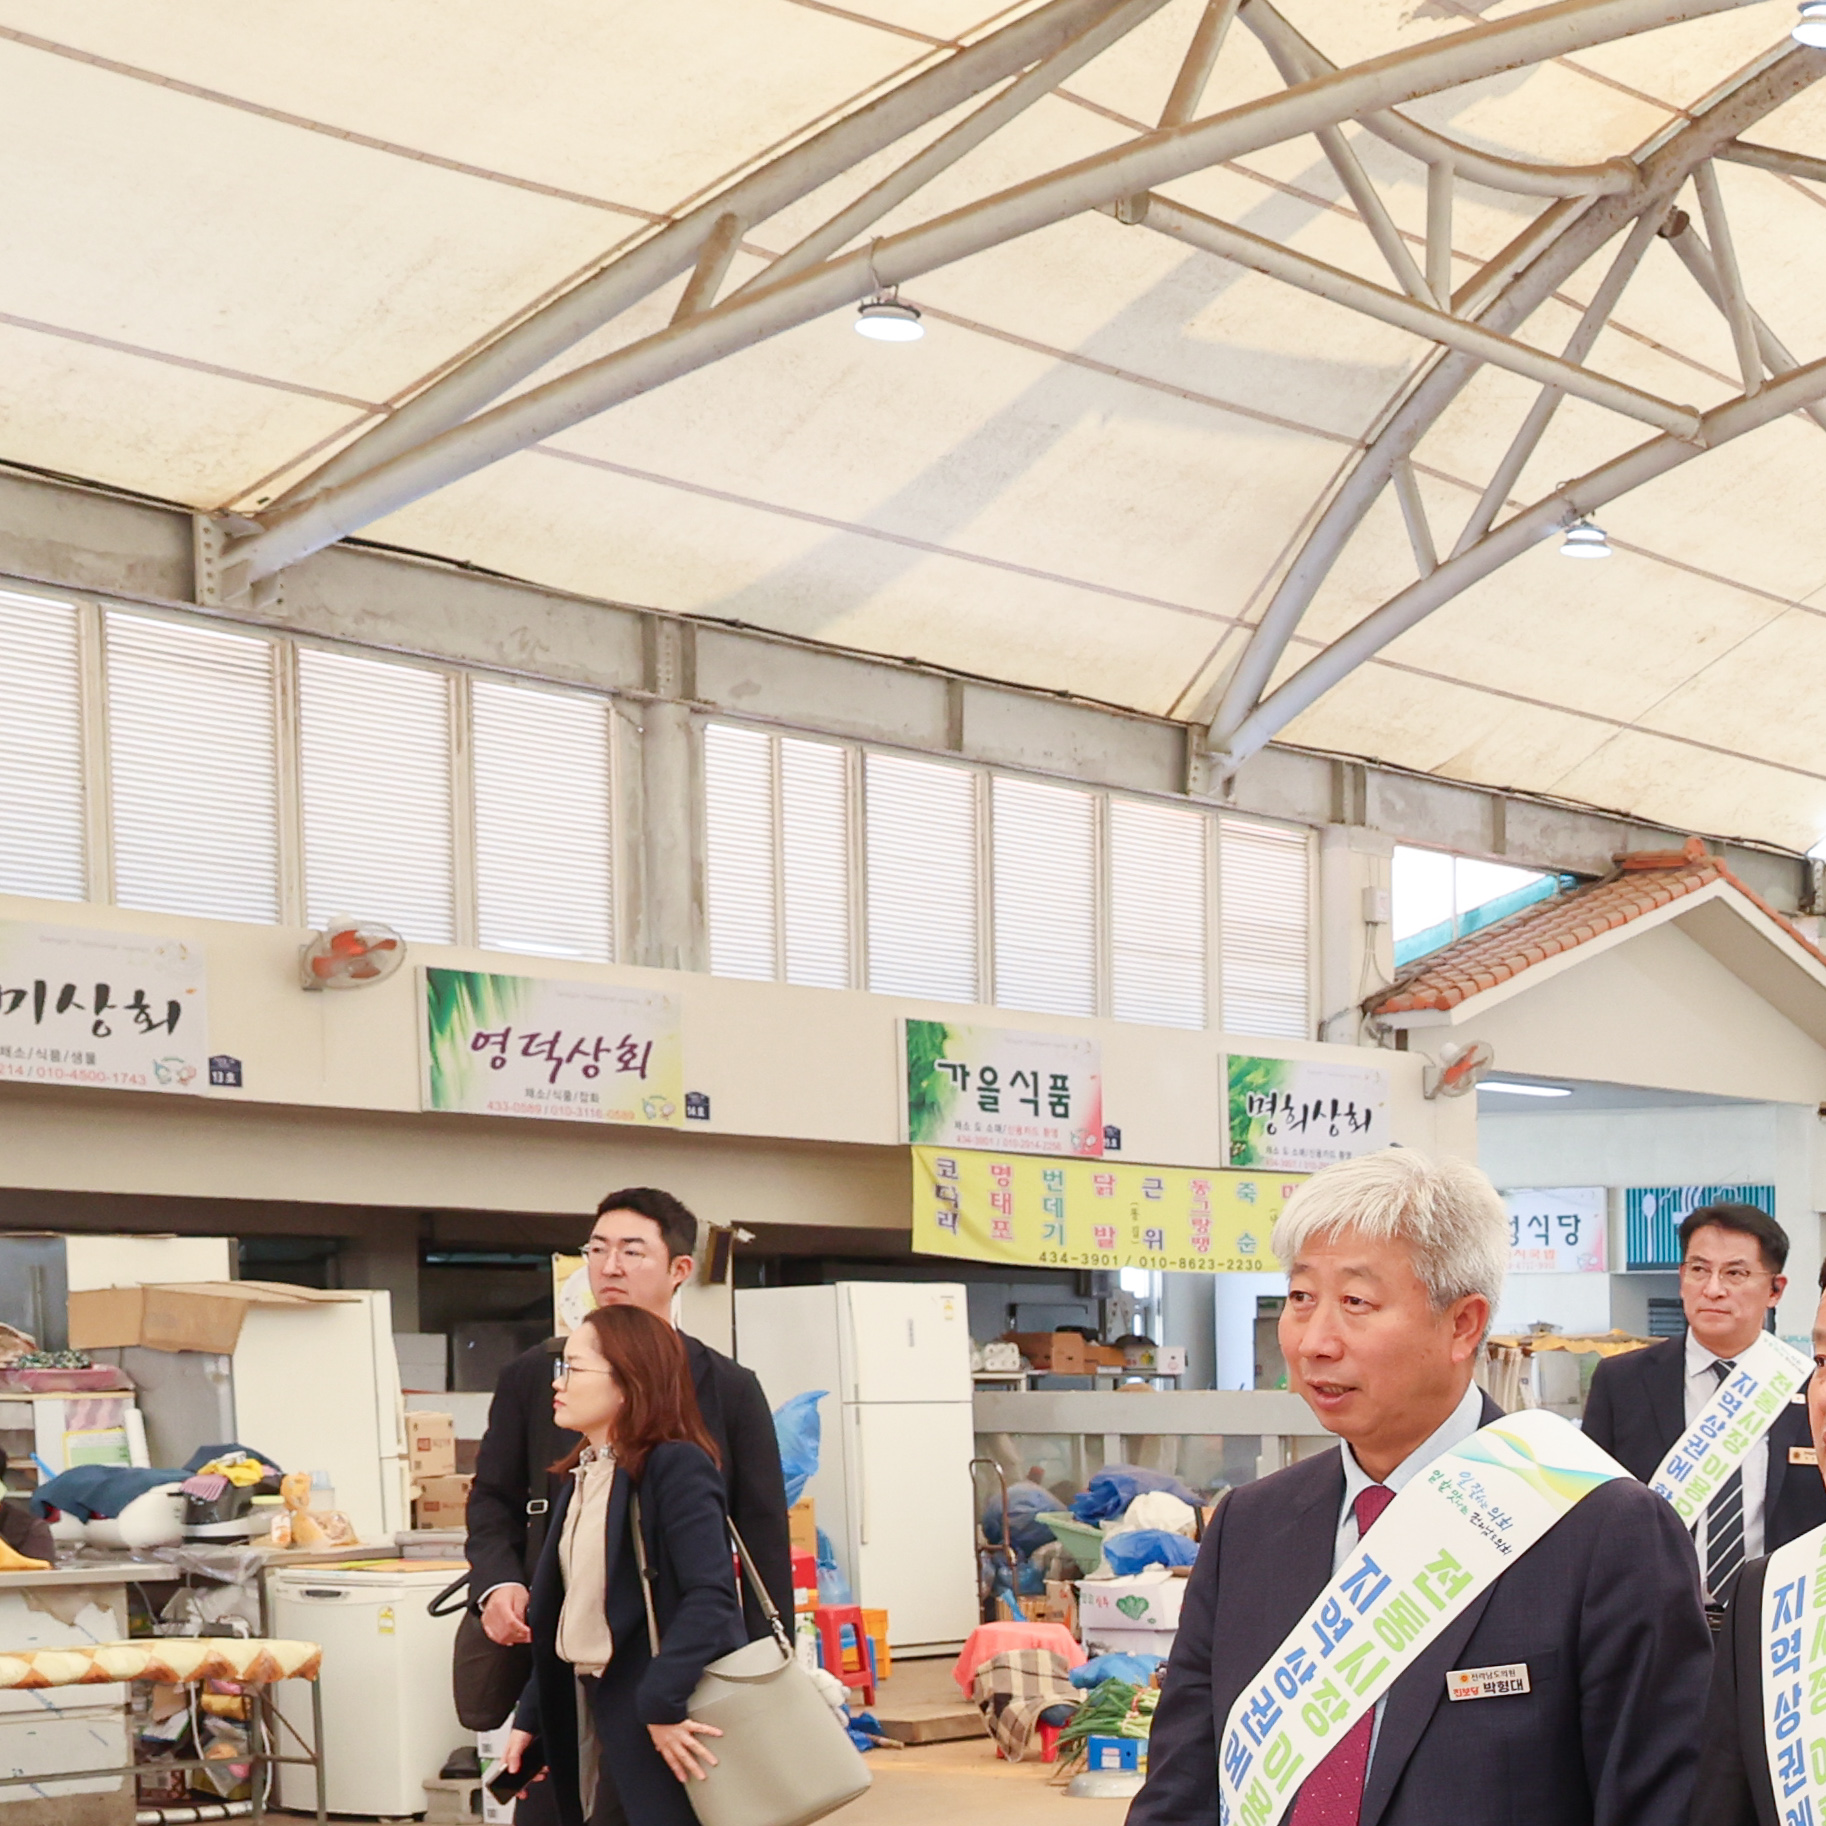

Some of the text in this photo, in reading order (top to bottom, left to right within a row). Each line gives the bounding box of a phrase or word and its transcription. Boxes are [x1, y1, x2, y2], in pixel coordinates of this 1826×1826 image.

[471, 1026, 653, 1084] 영덕상회
[937, 1061, 1071, 1119] 가을식품
[1248, 1091, 1372, 1137] 명희상회
[989, 1163, 1014, 1242] 명태포
[1042, 1168, 1066, 1247] 번데기
[1092, 1173, 1117, 1250] 닭발
[1141, 1177, 1165, 1251] 근위
[1190, 1179, 1212, 1254] 동그랑땡
[1235, 1181, 1258, 1255] 죽순
[1038, 1252, 1119, 1266] 434-3901
[1139, 1256, 1263, 1271] 010-8623-2230
[1666, 1371, 1759, 1483] 지역상권에
[1722, 1370, 1793, 1456] 전통시장
[1223, 1552, 1393, 1793] 지역상권에
[1300, 1547, 1474, 1738] 전통시장
[1483, 1678, 1524, 1695] 박형대
